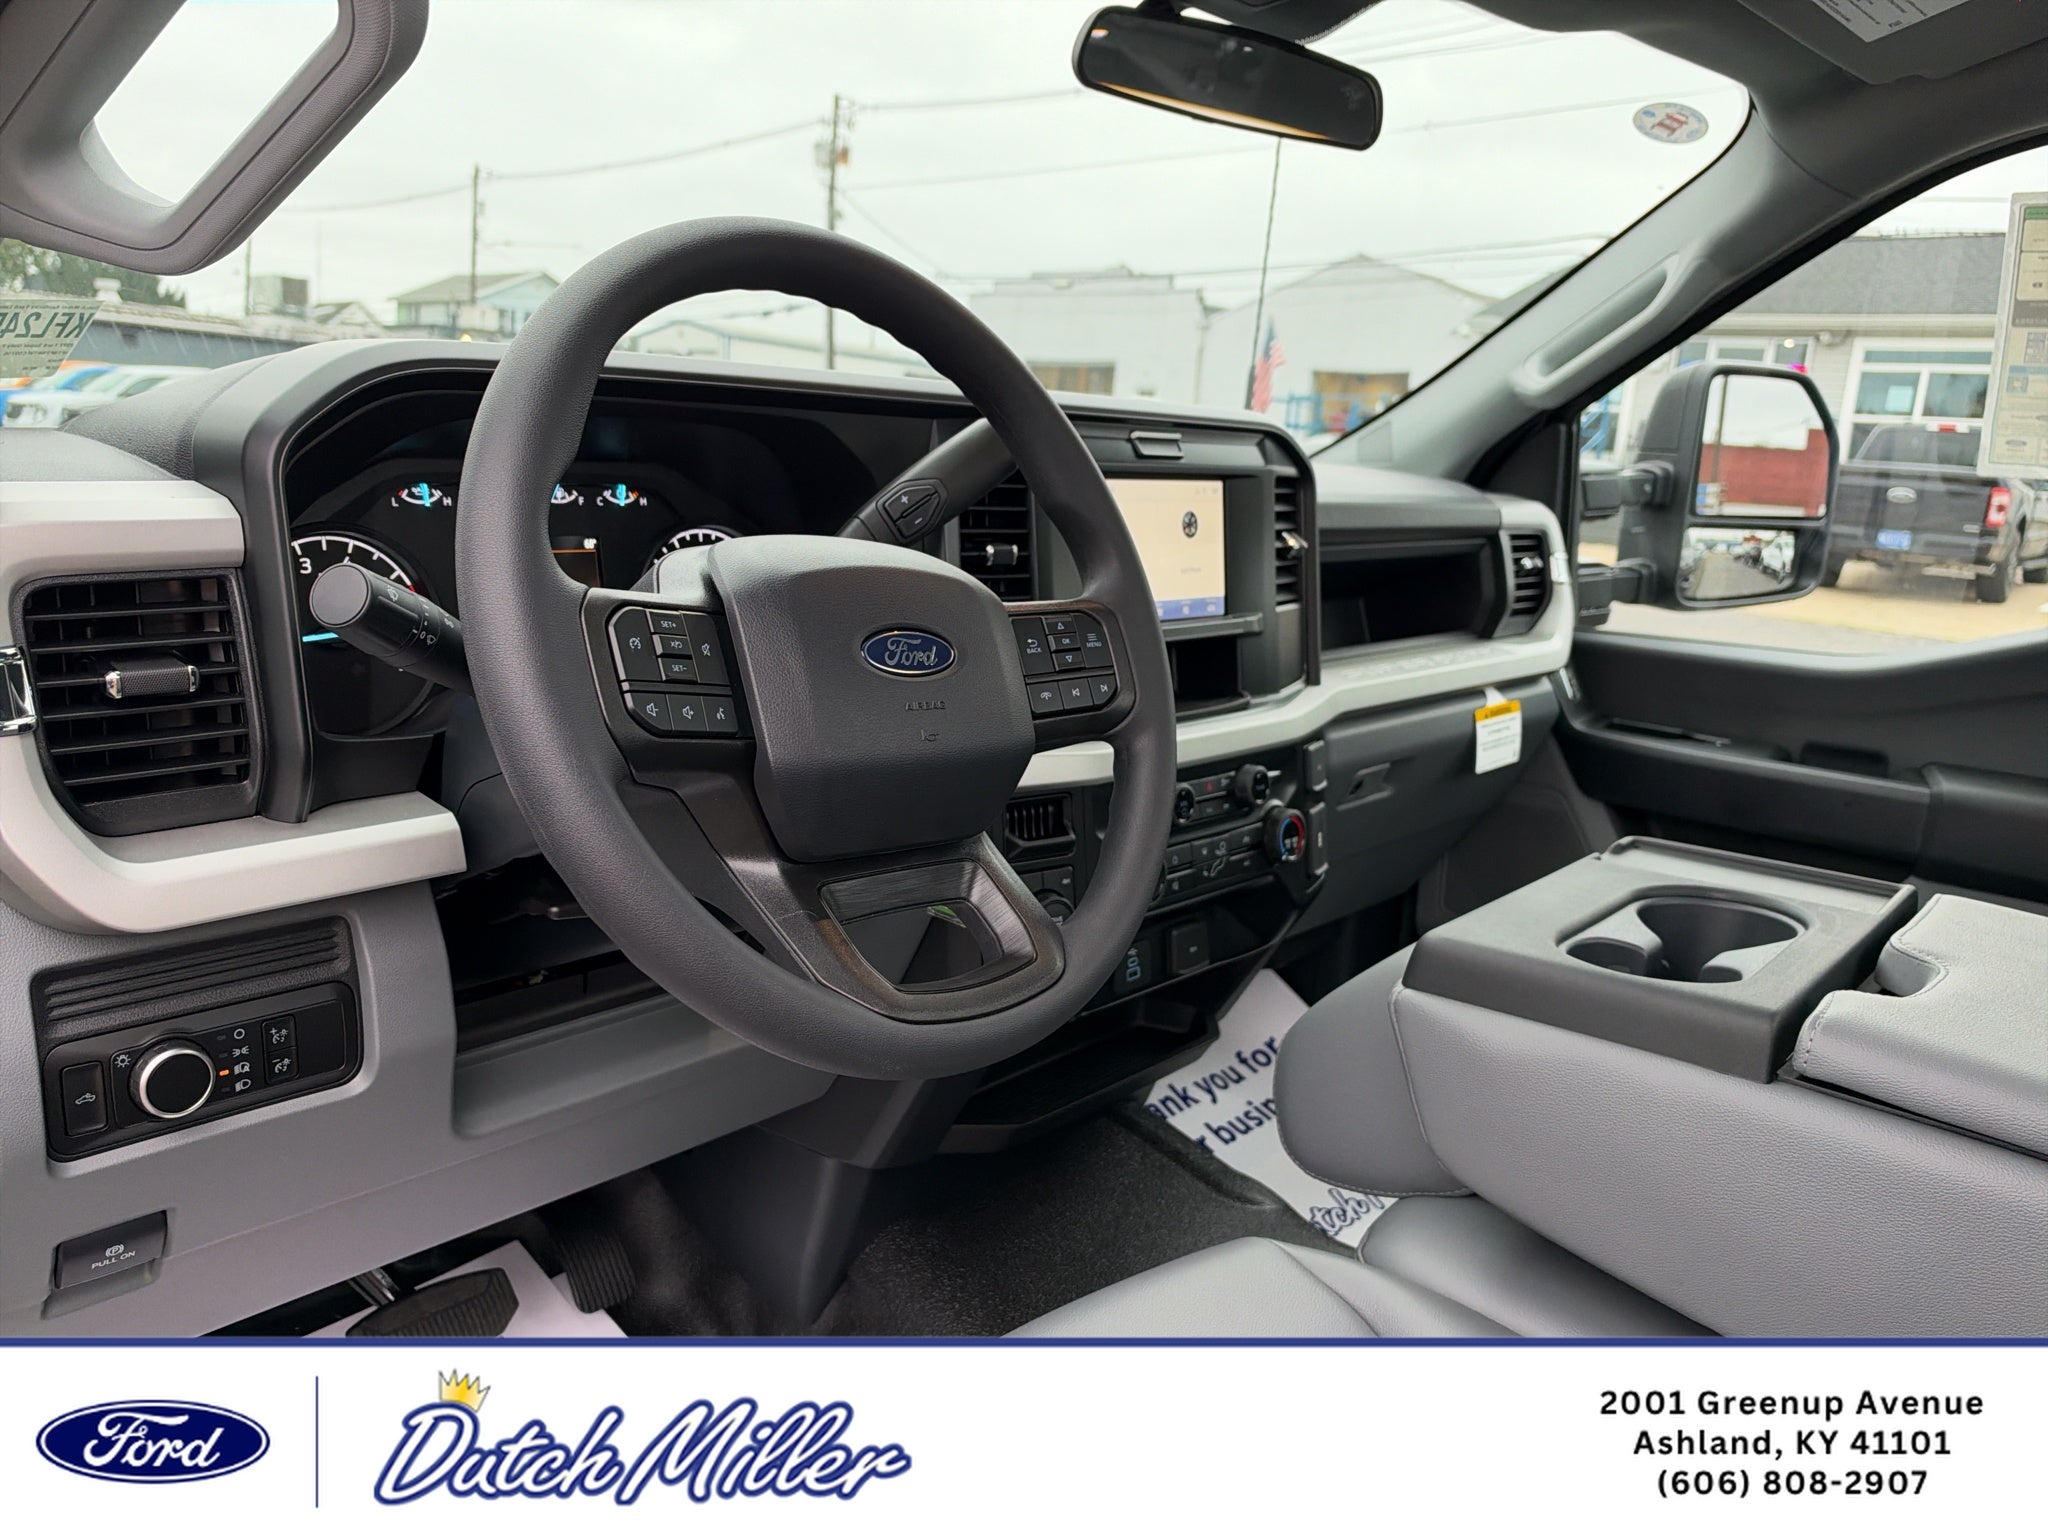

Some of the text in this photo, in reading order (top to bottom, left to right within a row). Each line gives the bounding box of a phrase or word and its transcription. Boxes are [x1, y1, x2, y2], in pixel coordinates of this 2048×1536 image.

[391, 496, 399, 507] L
[442, 496, 452, 507] H
[578, 496, 585, 506] F
[596, 496, 604, 506] C
[639, 496, 648, 506] H
[299, 557, 313, 574] 3
[884, 637, 938, 665] Ford
[905, 700, 946, 711] AIRBAG
[1193, 1065, 1247, 1105] you
[1235, 1036, 1279, 1073] for
[91, 1250, 136, 1269] PULL ON
